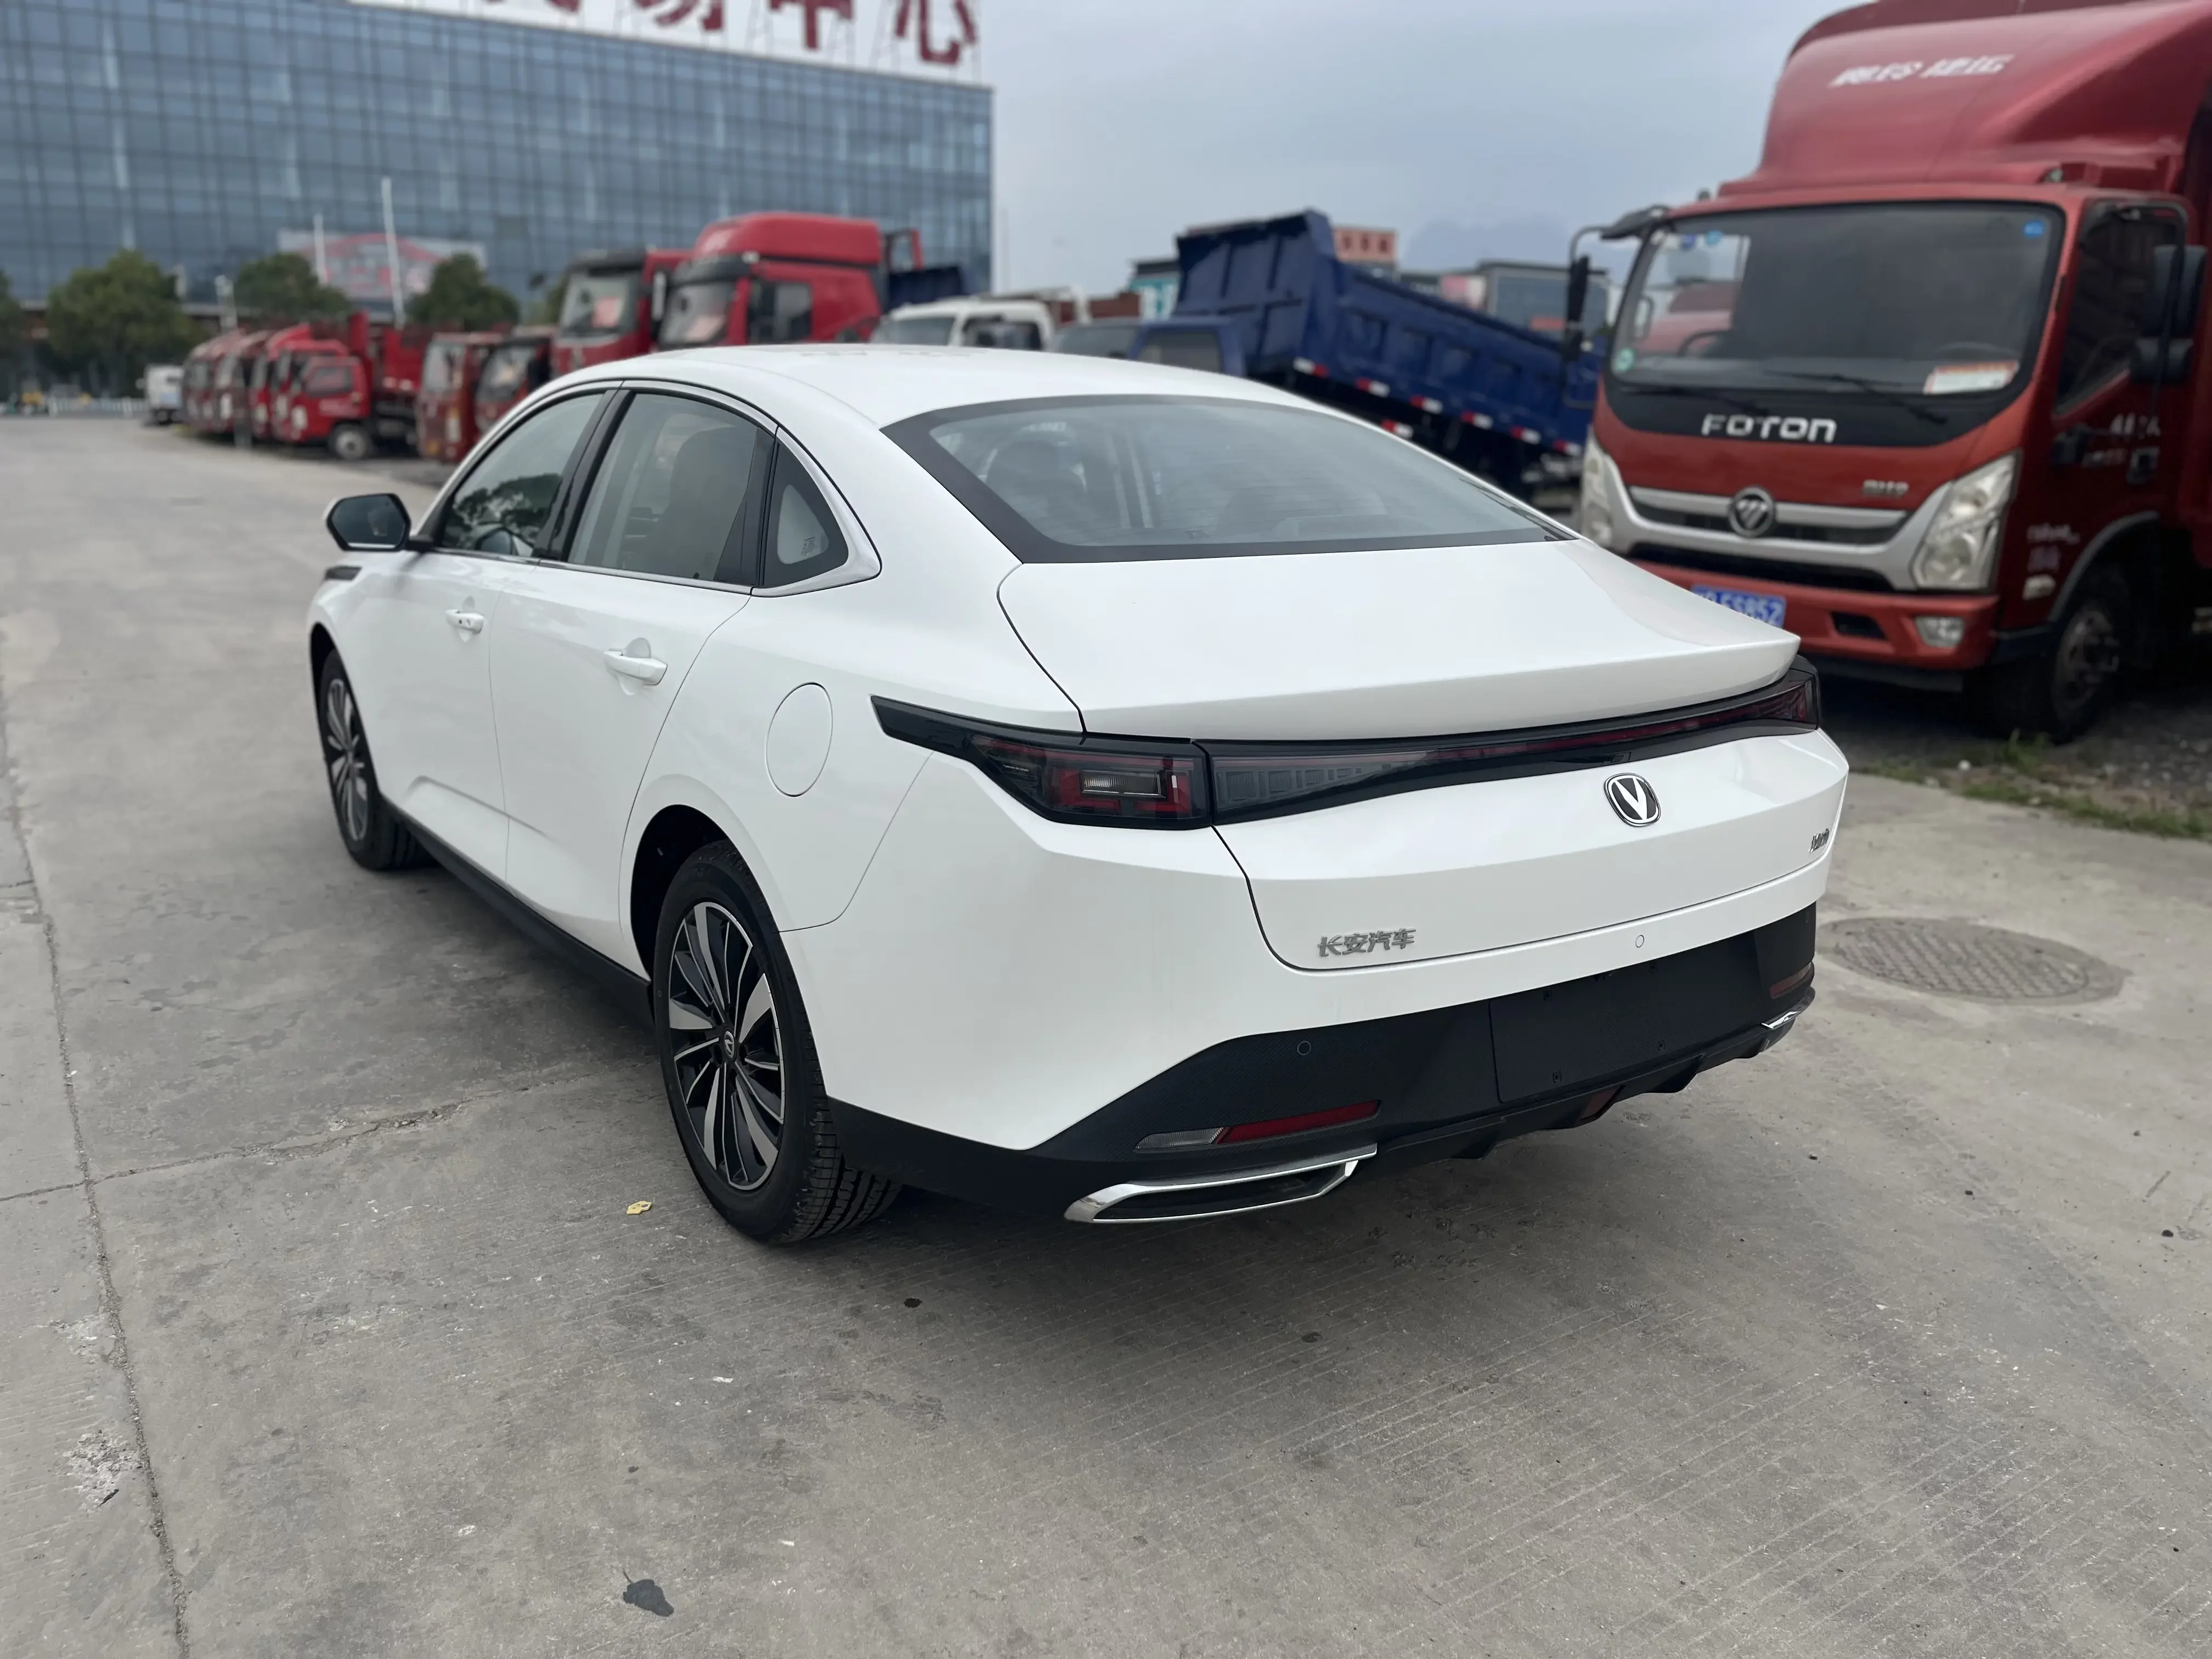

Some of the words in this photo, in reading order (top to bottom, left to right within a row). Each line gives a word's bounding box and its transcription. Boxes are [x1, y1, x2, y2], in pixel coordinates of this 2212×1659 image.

[1701, 413, 1837, 444] FOTON
[1317, 928, 1417, 957] 长安汽车
